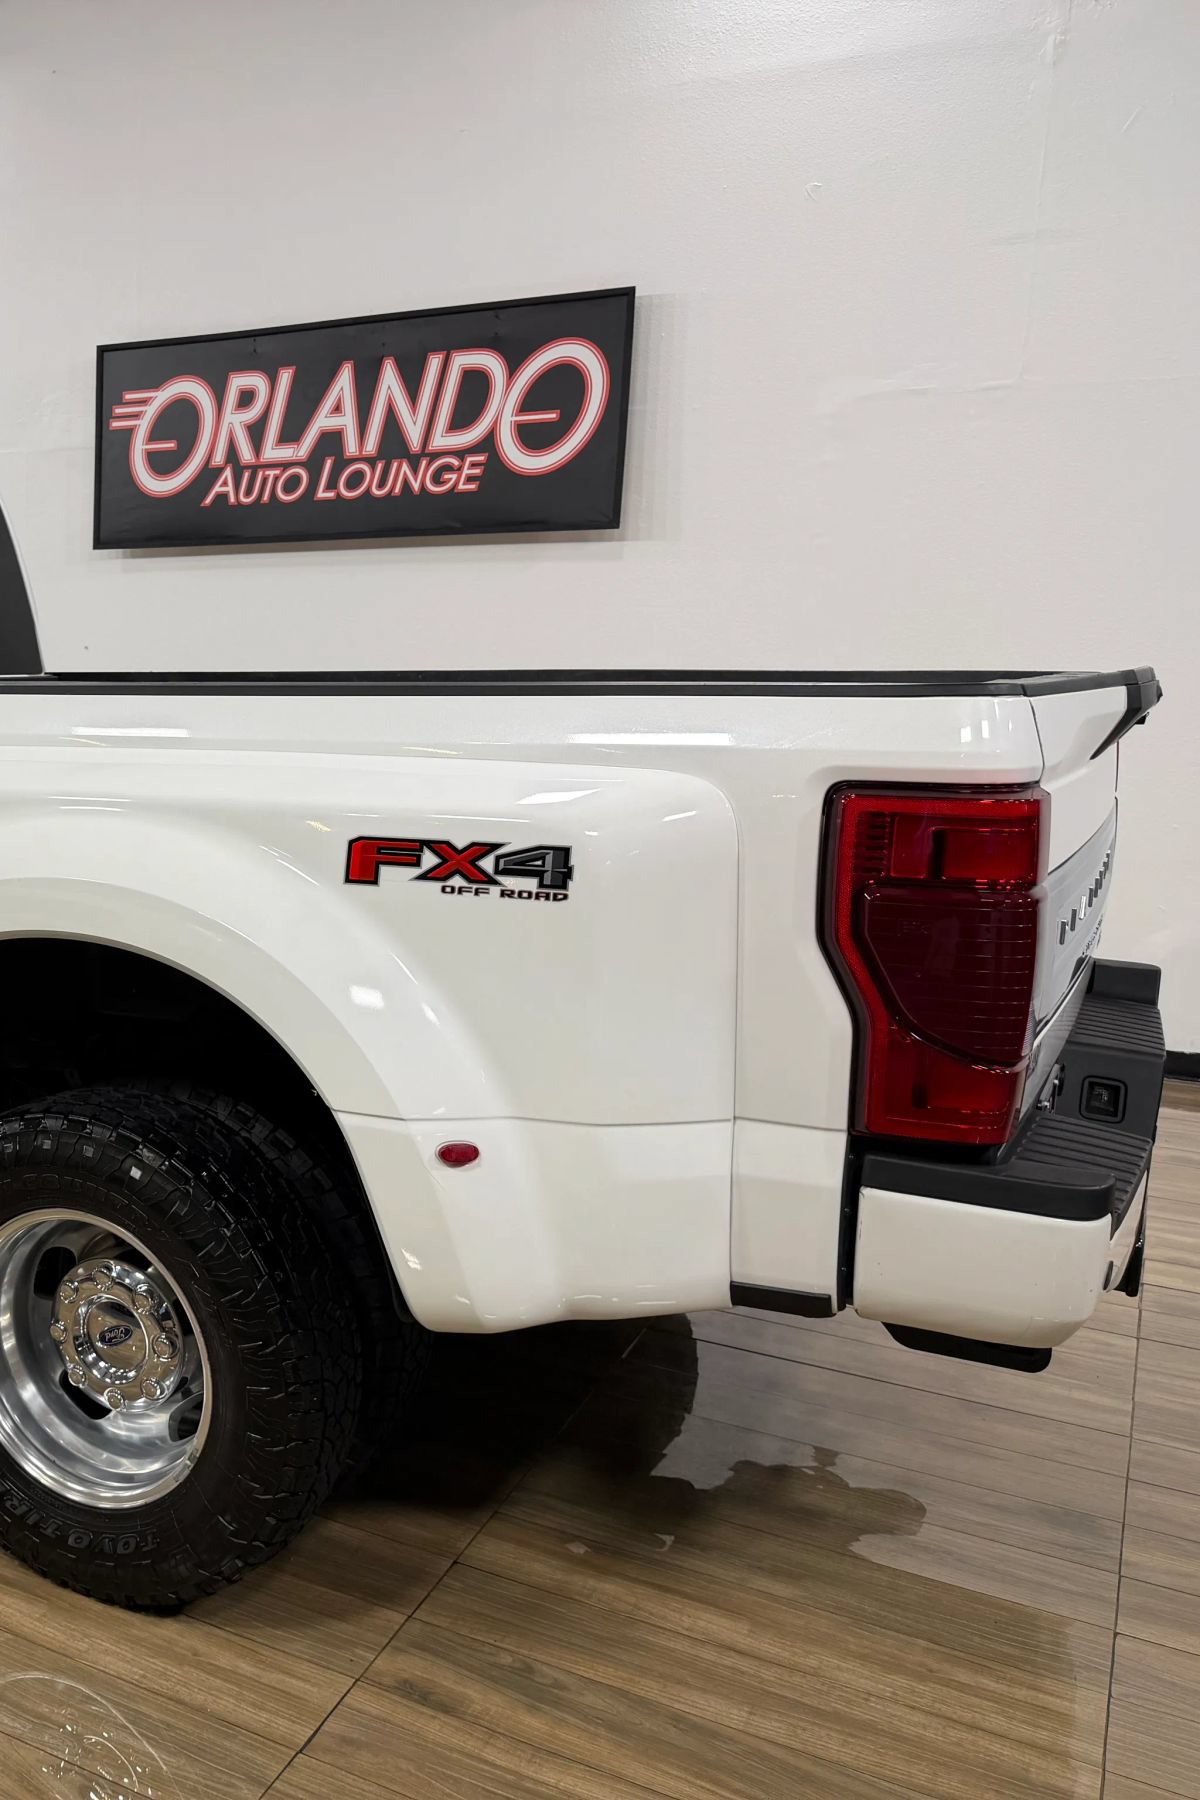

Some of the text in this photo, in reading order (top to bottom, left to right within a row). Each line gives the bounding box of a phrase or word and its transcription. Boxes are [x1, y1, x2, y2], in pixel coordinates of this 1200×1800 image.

[127, 336, 611, 498] ORLANDO
[200, 453, 489, 506] AUTO LOUNGE
[344, 836, 574, 892] FX4
[440, 884, 570, 902] OFF ROAD
